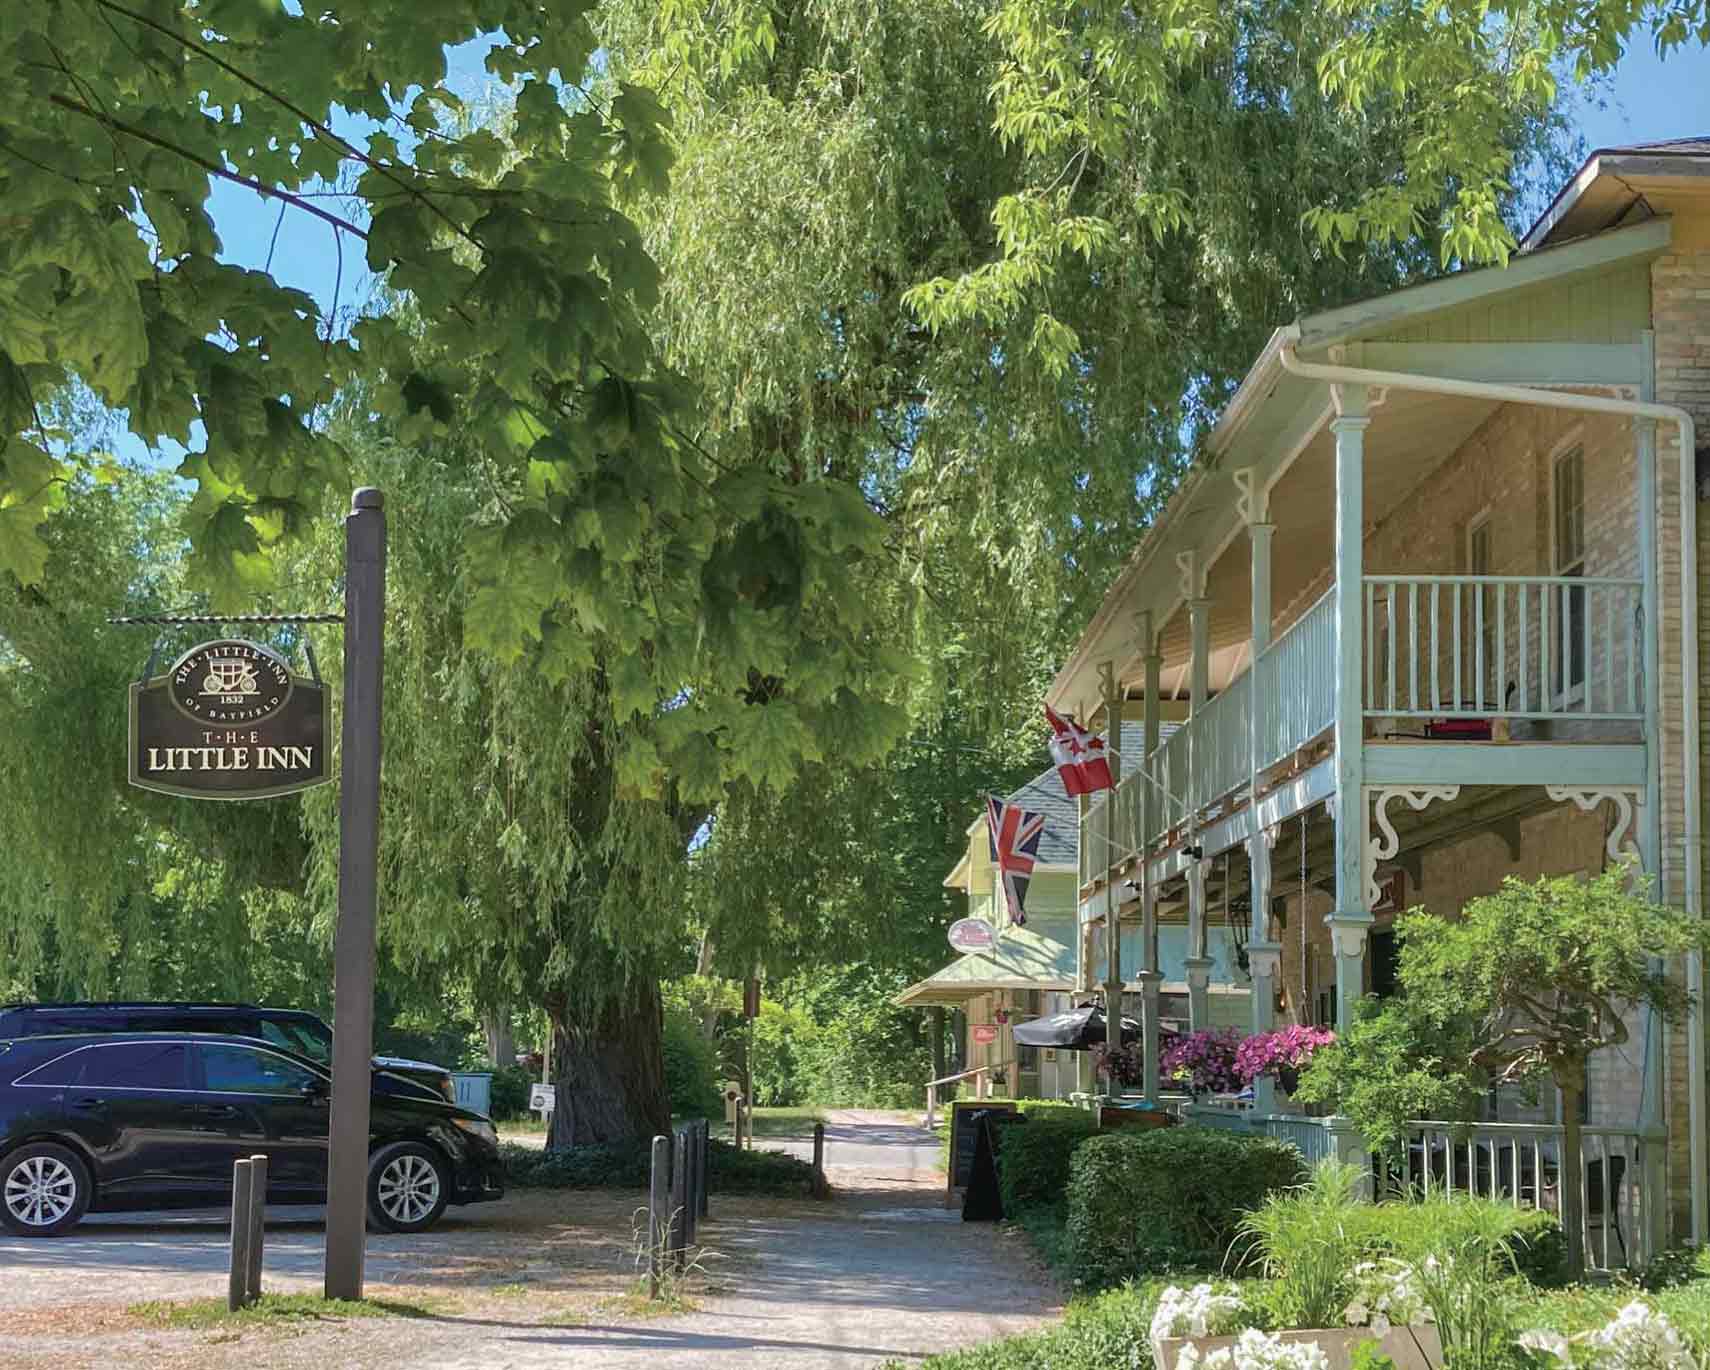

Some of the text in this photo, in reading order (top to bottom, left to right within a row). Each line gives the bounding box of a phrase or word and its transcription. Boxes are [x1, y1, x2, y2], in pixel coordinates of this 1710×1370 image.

[176, 647, 288, 685] THE LITTLE INN
[148, 746, 313, 771] LITTLE INN
